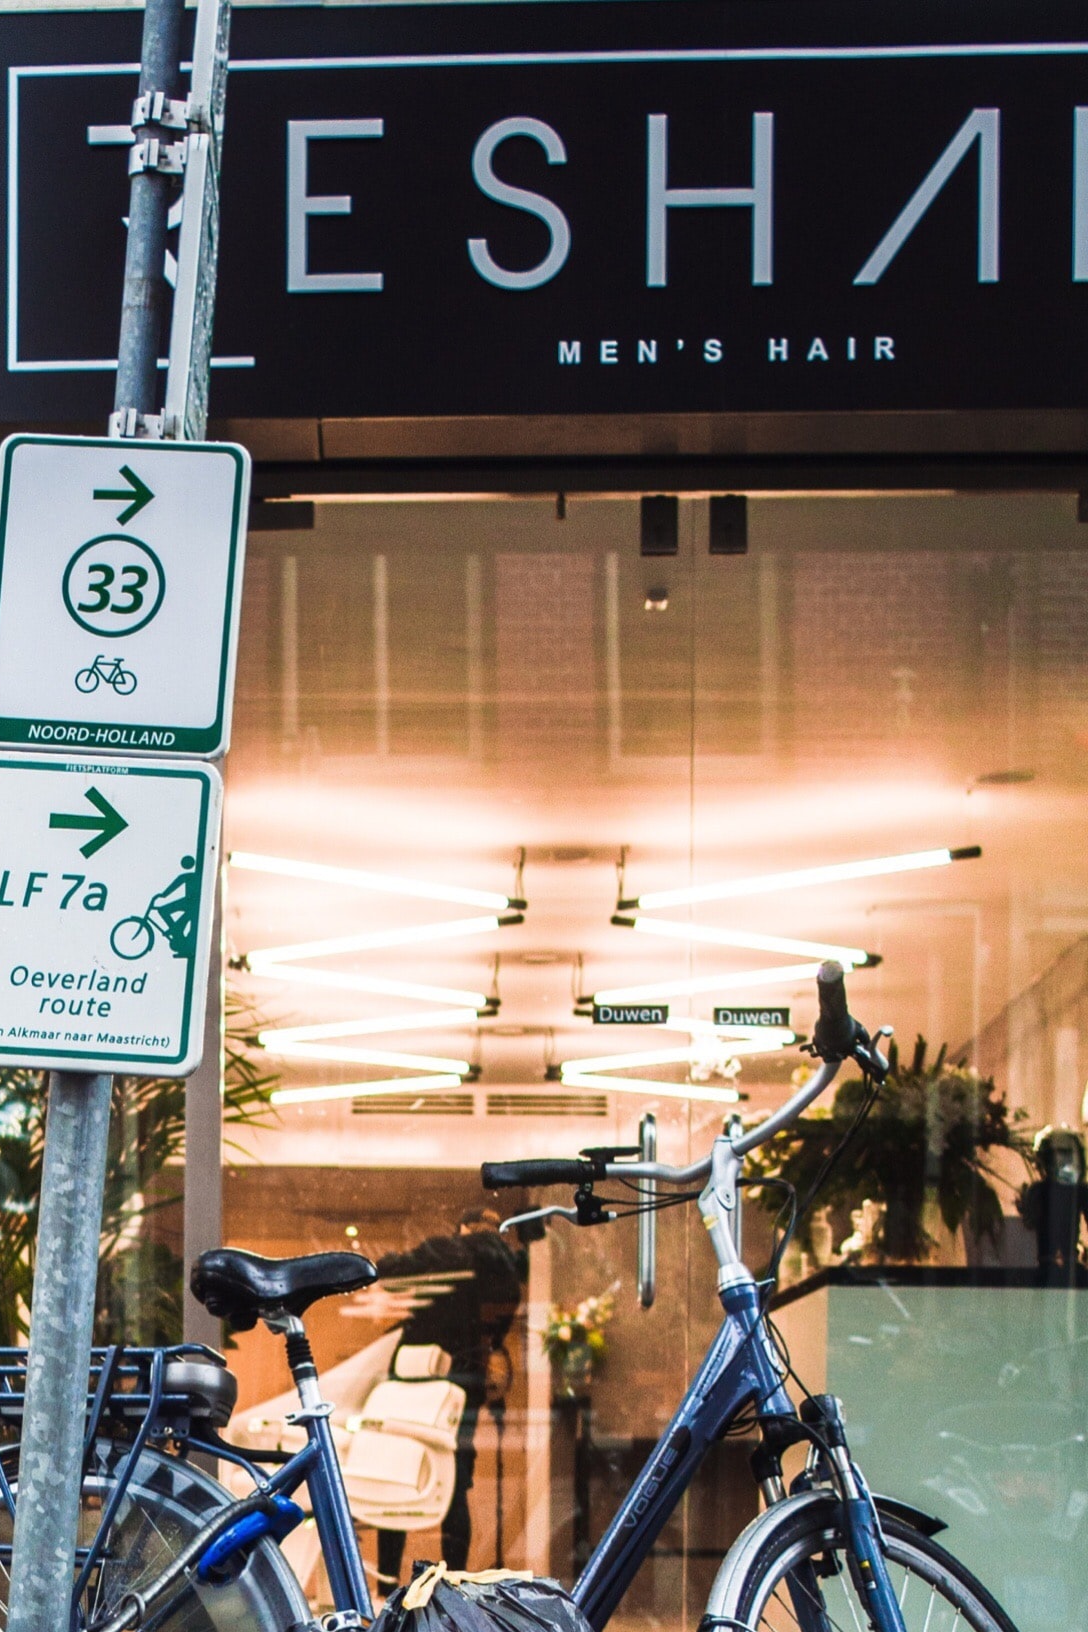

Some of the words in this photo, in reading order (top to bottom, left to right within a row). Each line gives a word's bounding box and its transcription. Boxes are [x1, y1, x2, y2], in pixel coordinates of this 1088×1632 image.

[768, 336, 896, 362] HAIR
[77, 563, 149, 614] 33
[27, 724, 176, 747] NOORD-HOLLAND
[65, 762, 129, 775] FIETSPLATFORM
[59, 874, 108, 912] 7a
[10, 965, 148, 994] Oeverland
[38, 997, 112, 1018] route
[599, 1007, 663, 1022] Duwen
[718, 1009, 782, 1025] Duwen
[7, 1026, 61, 1040] Alkmaar
[64, 1032, 94, 1042] naar
[97, 1032, 170, 1049] Maastricht)
[625, 1447, 679, 1528] VOGUE
